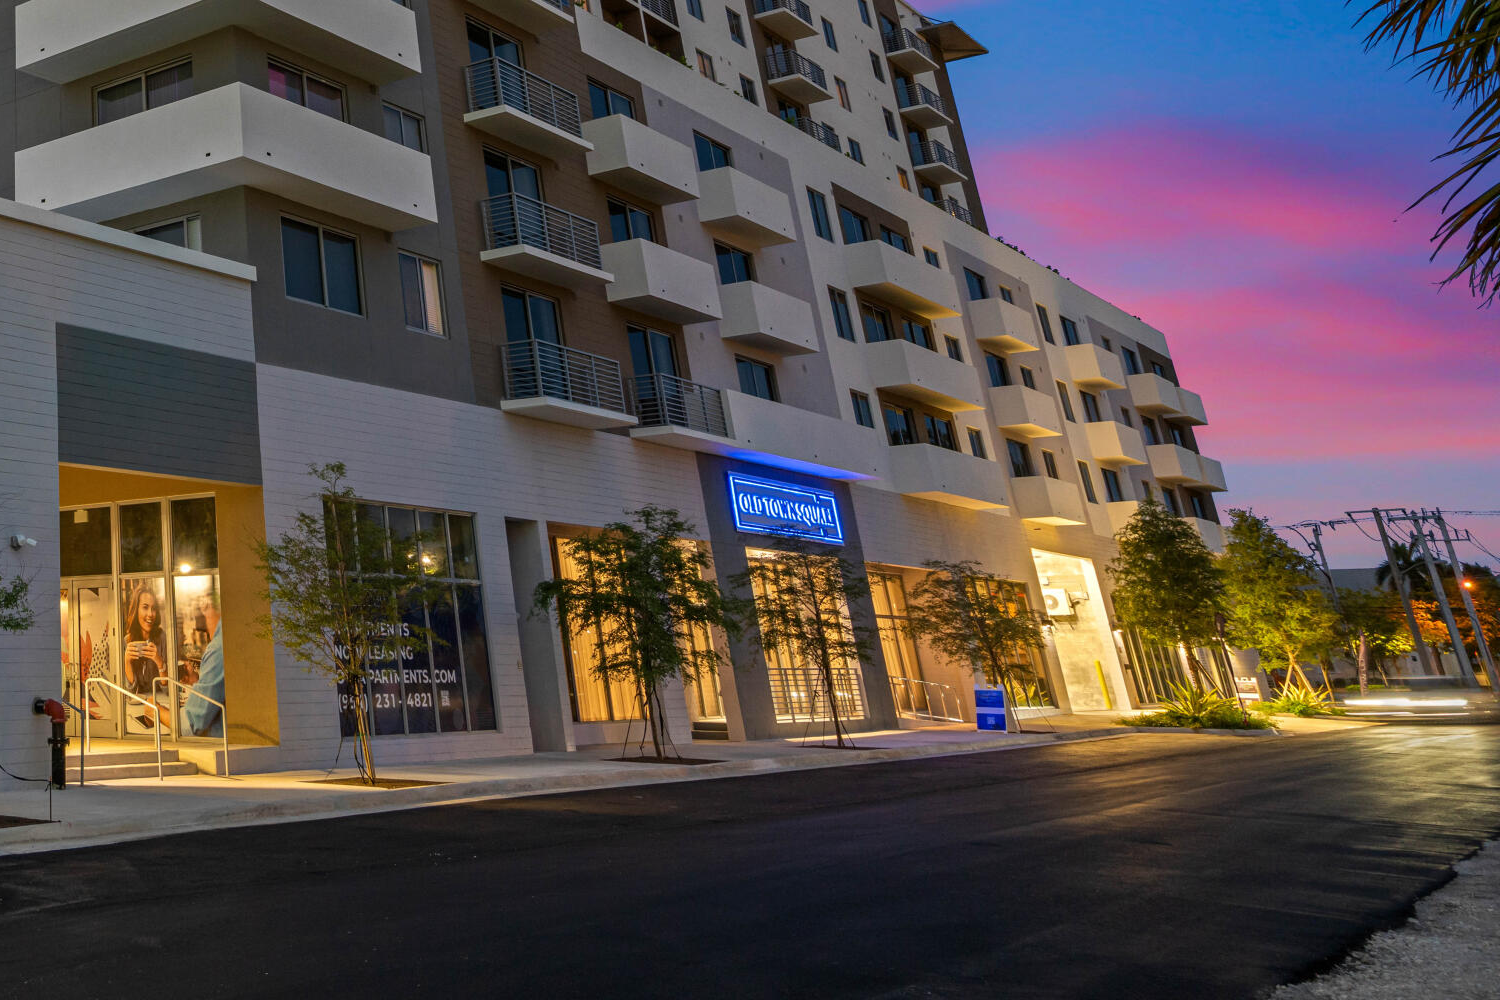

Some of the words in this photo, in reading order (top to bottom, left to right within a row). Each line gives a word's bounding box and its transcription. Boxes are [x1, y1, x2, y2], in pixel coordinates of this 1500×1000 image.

[739, 493, 763, 515] OLD
[338, 693, 369, 713] (95)
[375, 693, 396, 708] 231
[407, 692, 432, 708] 4821
